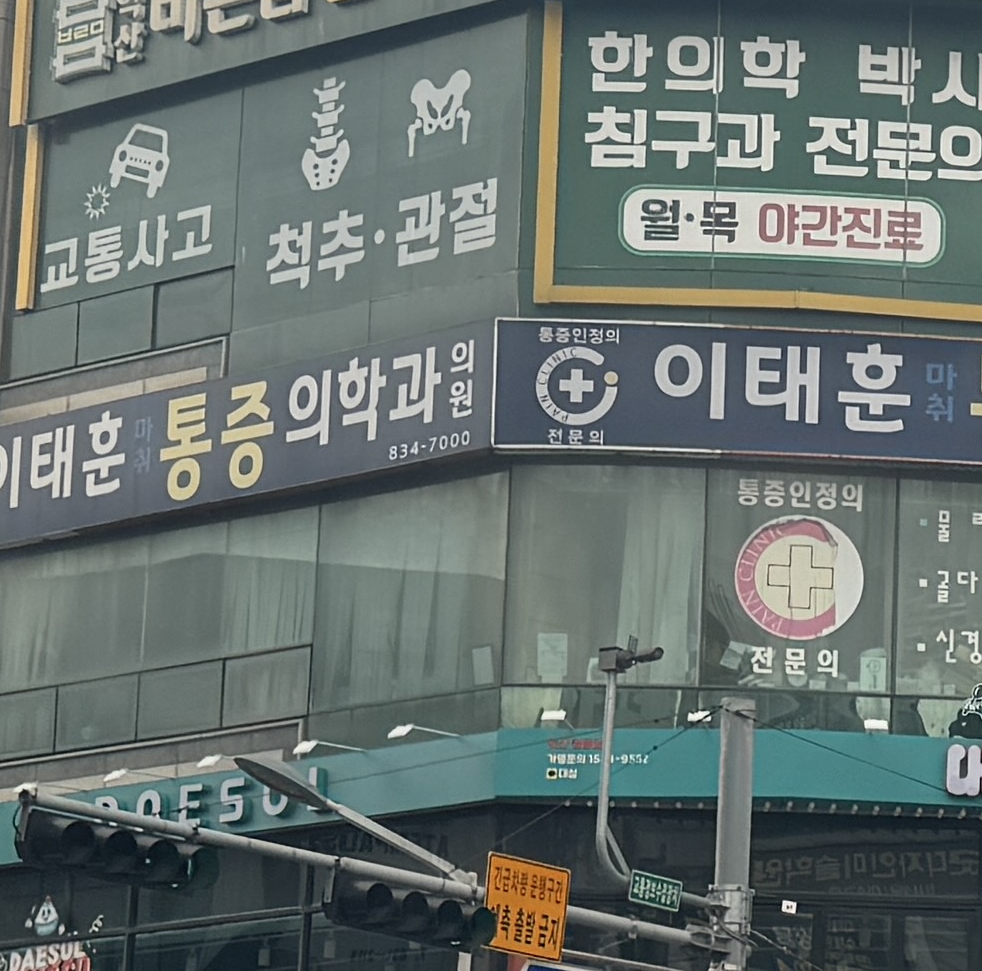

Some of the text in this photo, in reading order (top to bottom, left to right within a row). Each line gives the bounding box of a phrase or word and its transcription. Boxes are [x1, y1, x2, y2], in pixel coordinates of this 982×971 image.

[588, 31, 806, 99] 한의학
[584, 106, 780, 171] 침구과
[40, 205, 212, 293] 교통사고
[640, 199, 924, 250] 월·목 야간진료
[539, 326, 619, 344] 통증인정의
[654, 341, 911, 433] 이태훈
[925, 362, 958, 424] 마취
[159, 380, 275, 502] 통증
[285, 346, 442, 446] 의학과
[449, 339, 475, 419] 의원
[388, 430, 471, 461] 834-7000
[547, 428, 603, 446] 전문의
[738, 478, 863, 512] 통증인정의
[750, 646, 839, 678] 전문의
